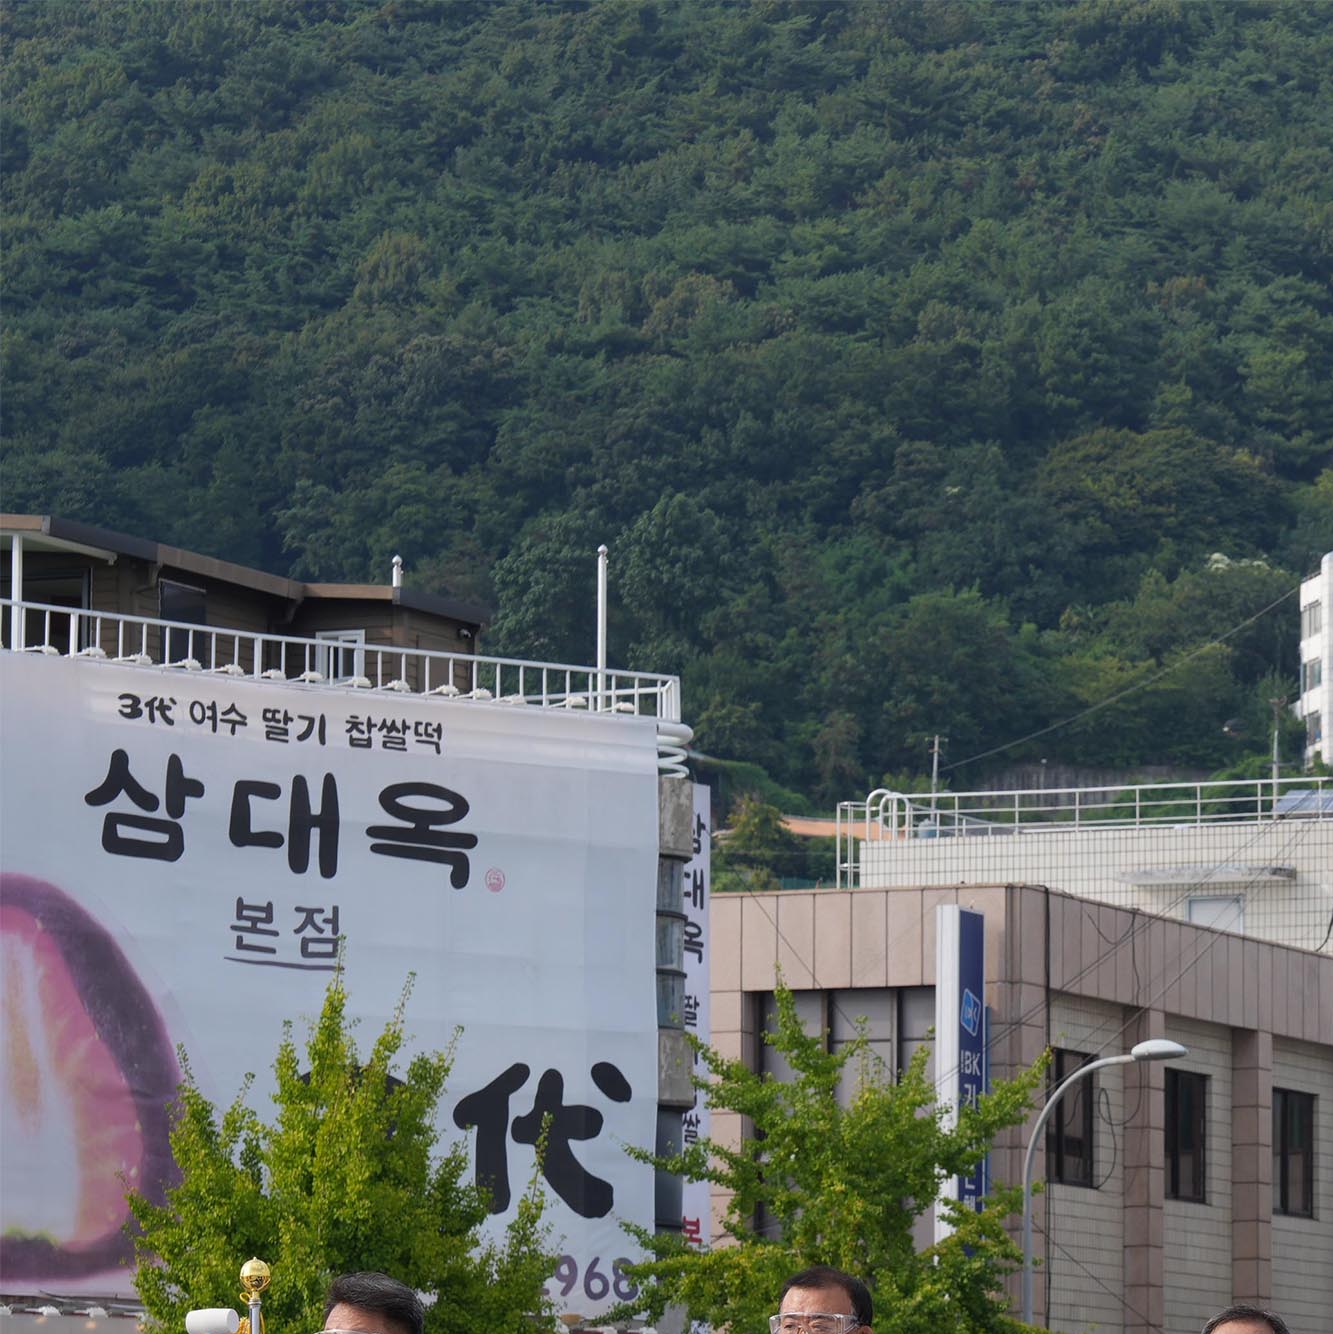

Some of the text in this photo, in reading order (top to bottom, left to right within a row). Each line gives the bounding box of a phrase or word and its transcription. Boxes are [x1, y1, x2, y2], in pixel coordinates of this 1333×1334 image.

[188, 700, 249, 737] 여수
[261, 706, 328, 746] 딸기
[344, 714, 445, 755] 찹쌀떡
[84, 747, 479, 890] 삼대옥
[229, 897, 345, 960] 본점
[960, 1050, 981, 1077] IBK
